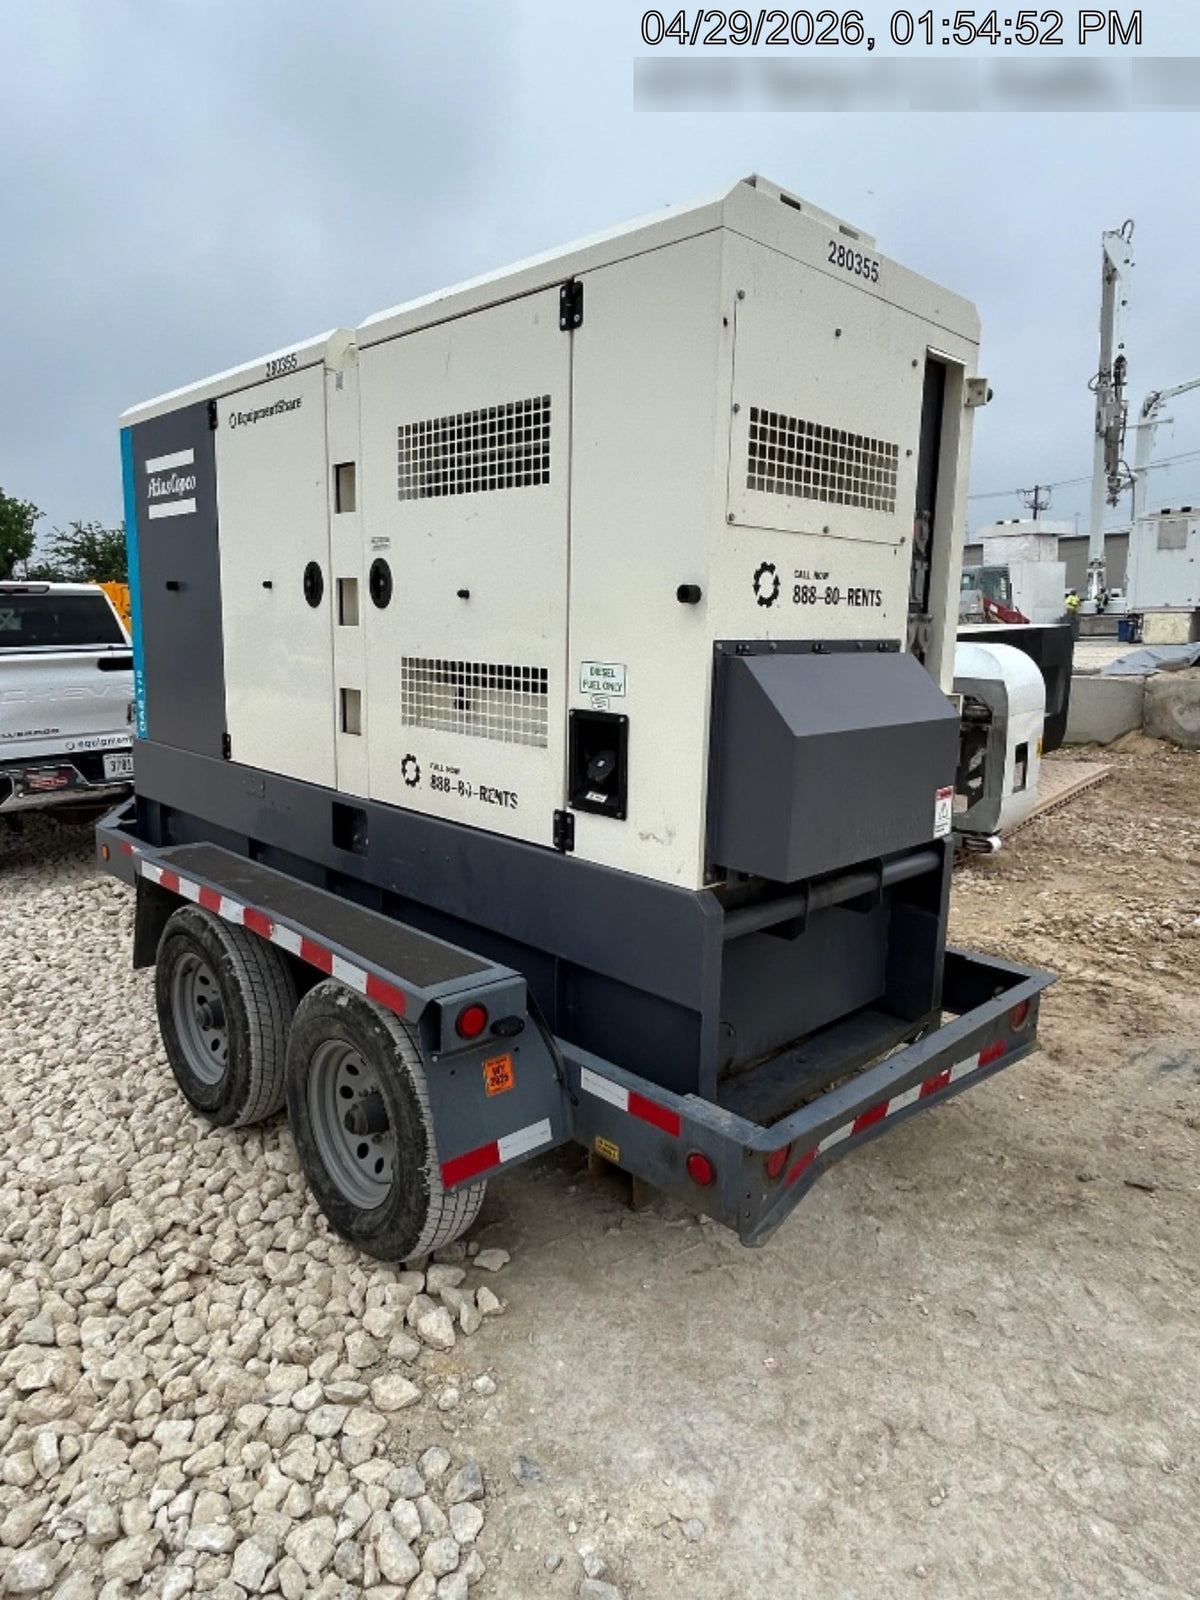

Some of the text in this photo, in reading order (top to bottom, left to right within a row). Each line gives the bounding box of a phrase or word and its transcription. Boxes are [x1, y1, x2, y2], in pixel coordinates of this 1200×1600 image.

[827, 240, 880, 284] 280355
[265, 352, 299, 378] 280355
[237, 396, 303, 427] EquipmentShare
[147, 472, 197, 498] Atlas Copco
[794, 569, 829, 580] CALL NOW
[792, 584, 883, 607] 888-80-RENTS
[590, 666, 616, 678] DIESEL
[583, 679, 623, 693] FUEL ONLY
[430, 774, 519, 810] 888-80-RENTS
